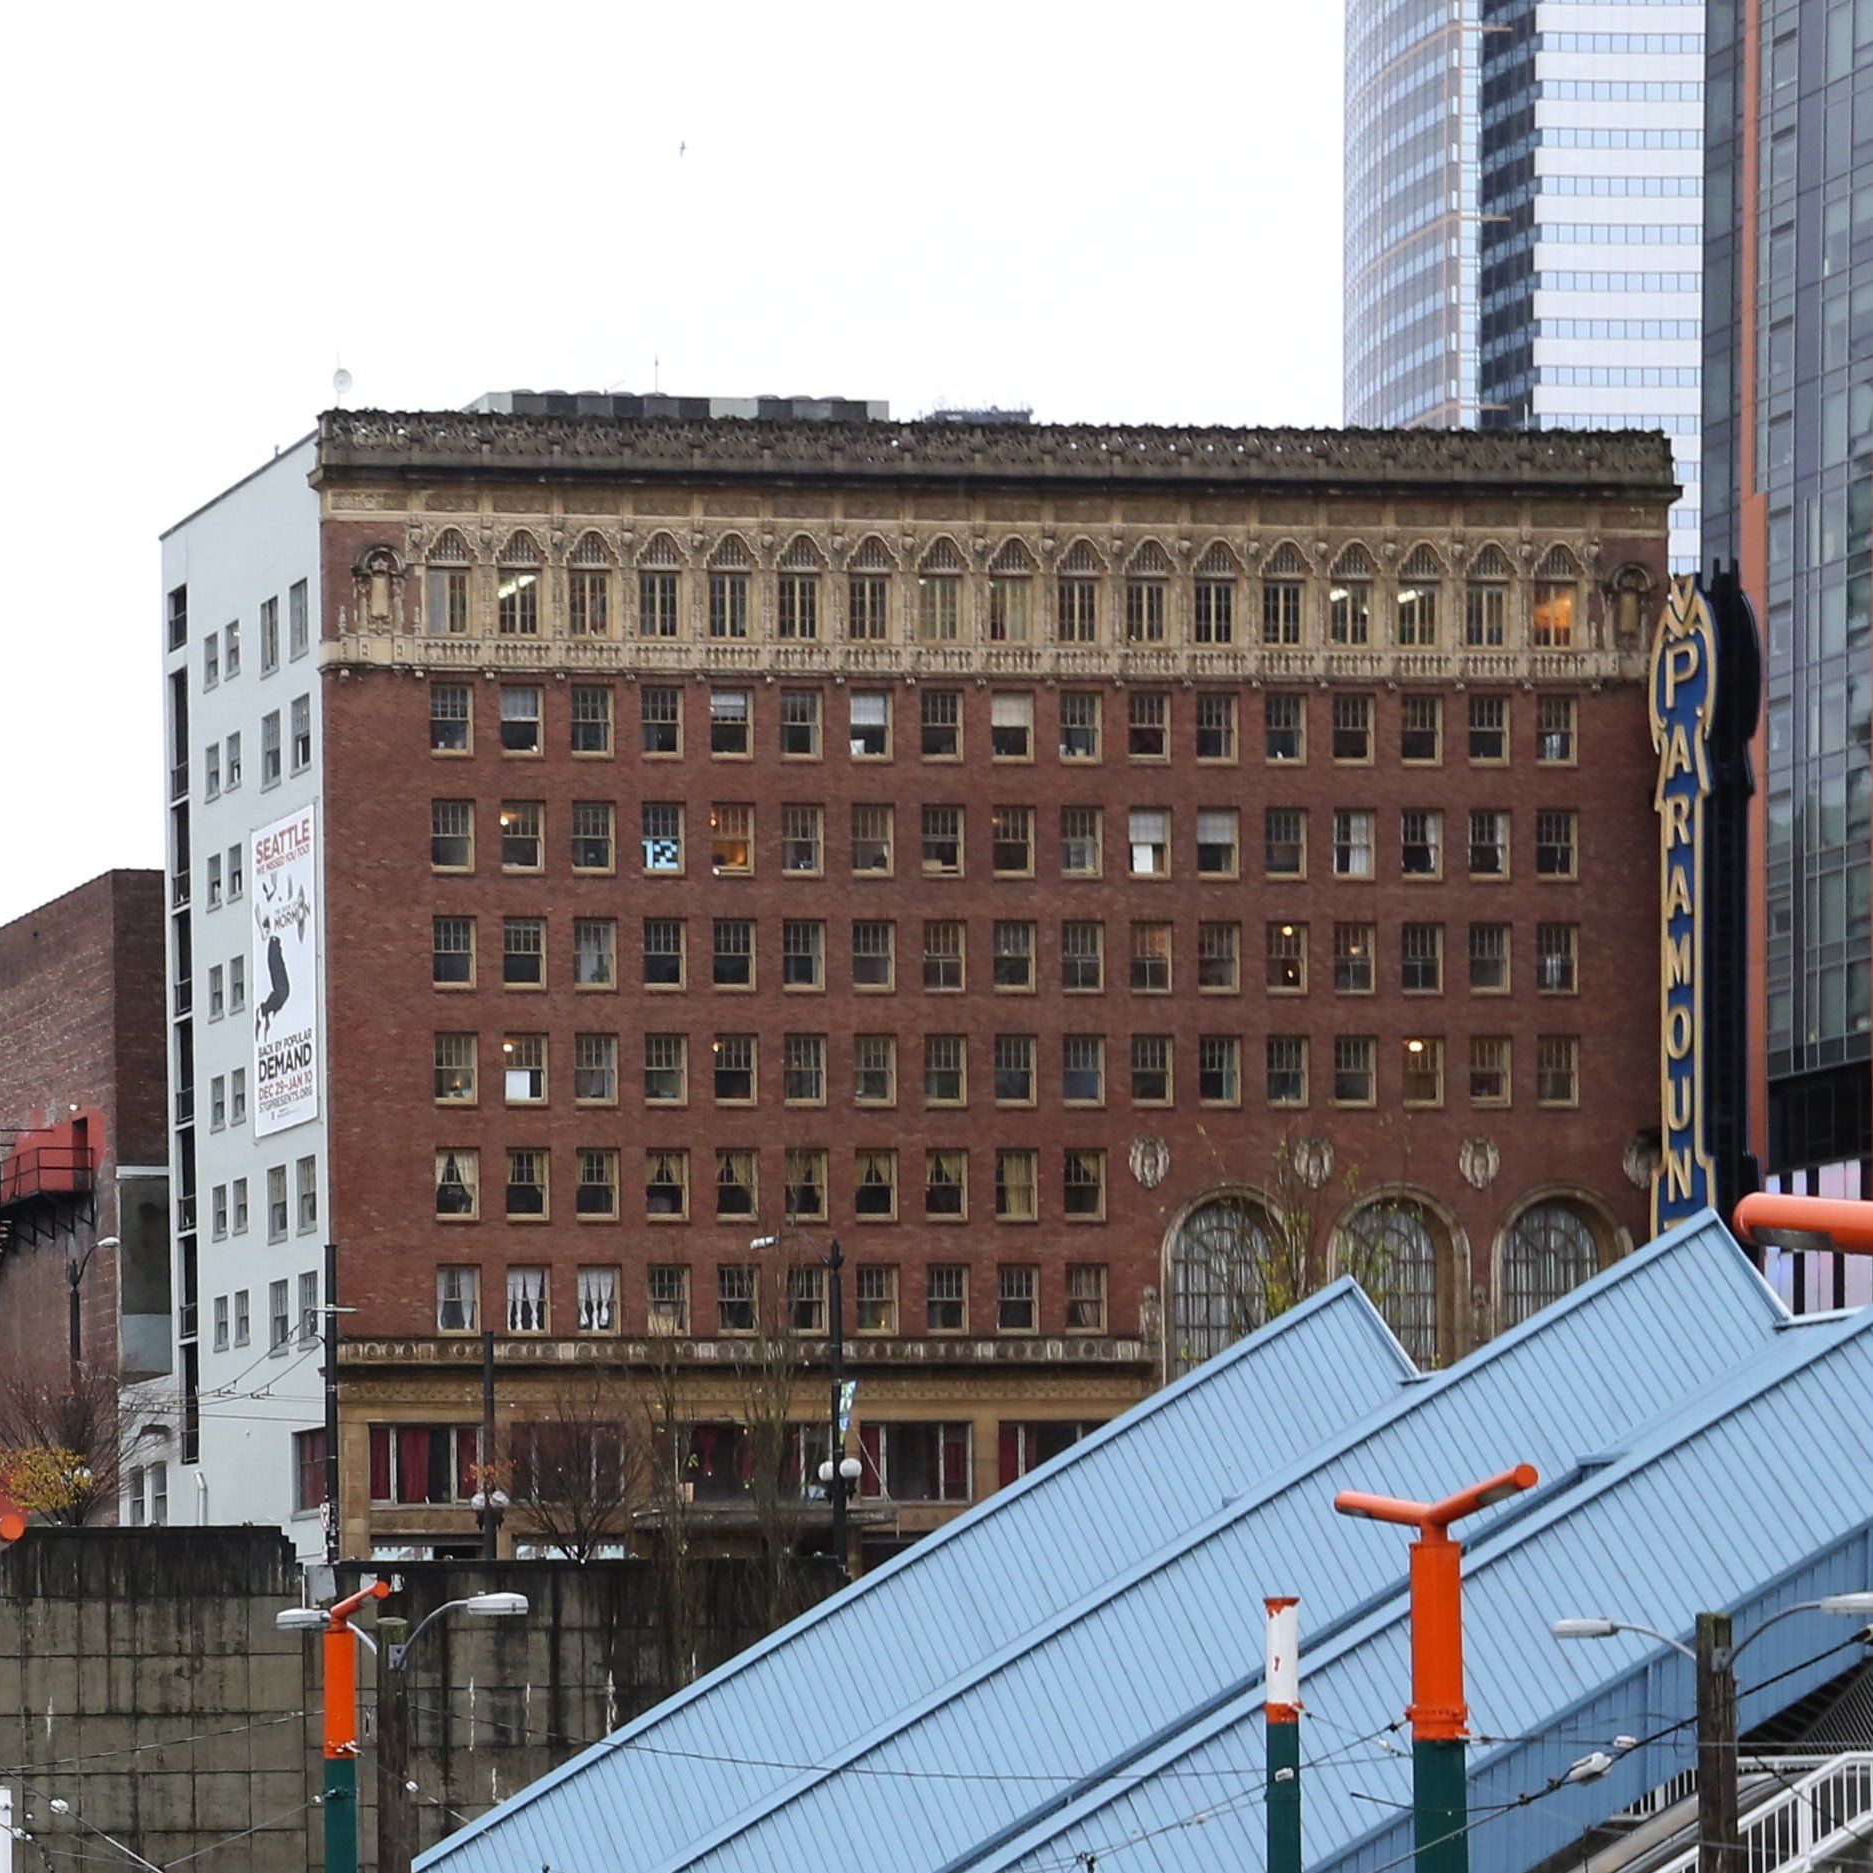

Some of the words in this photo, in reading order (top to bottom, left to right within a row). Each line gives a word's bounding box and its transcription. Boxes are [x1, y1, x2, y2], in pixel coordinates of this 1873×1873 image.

[256, 818, 310, 865] SEATTLE
[274, 901, 311, 932] MORMON
[259, 1044, 274, 1058] BACK
[284, 1028, 312, 1047] POPULAR
[259, 1042, 312, 1083] DEMAND
[259, 1083, 273, 1100] DEC
